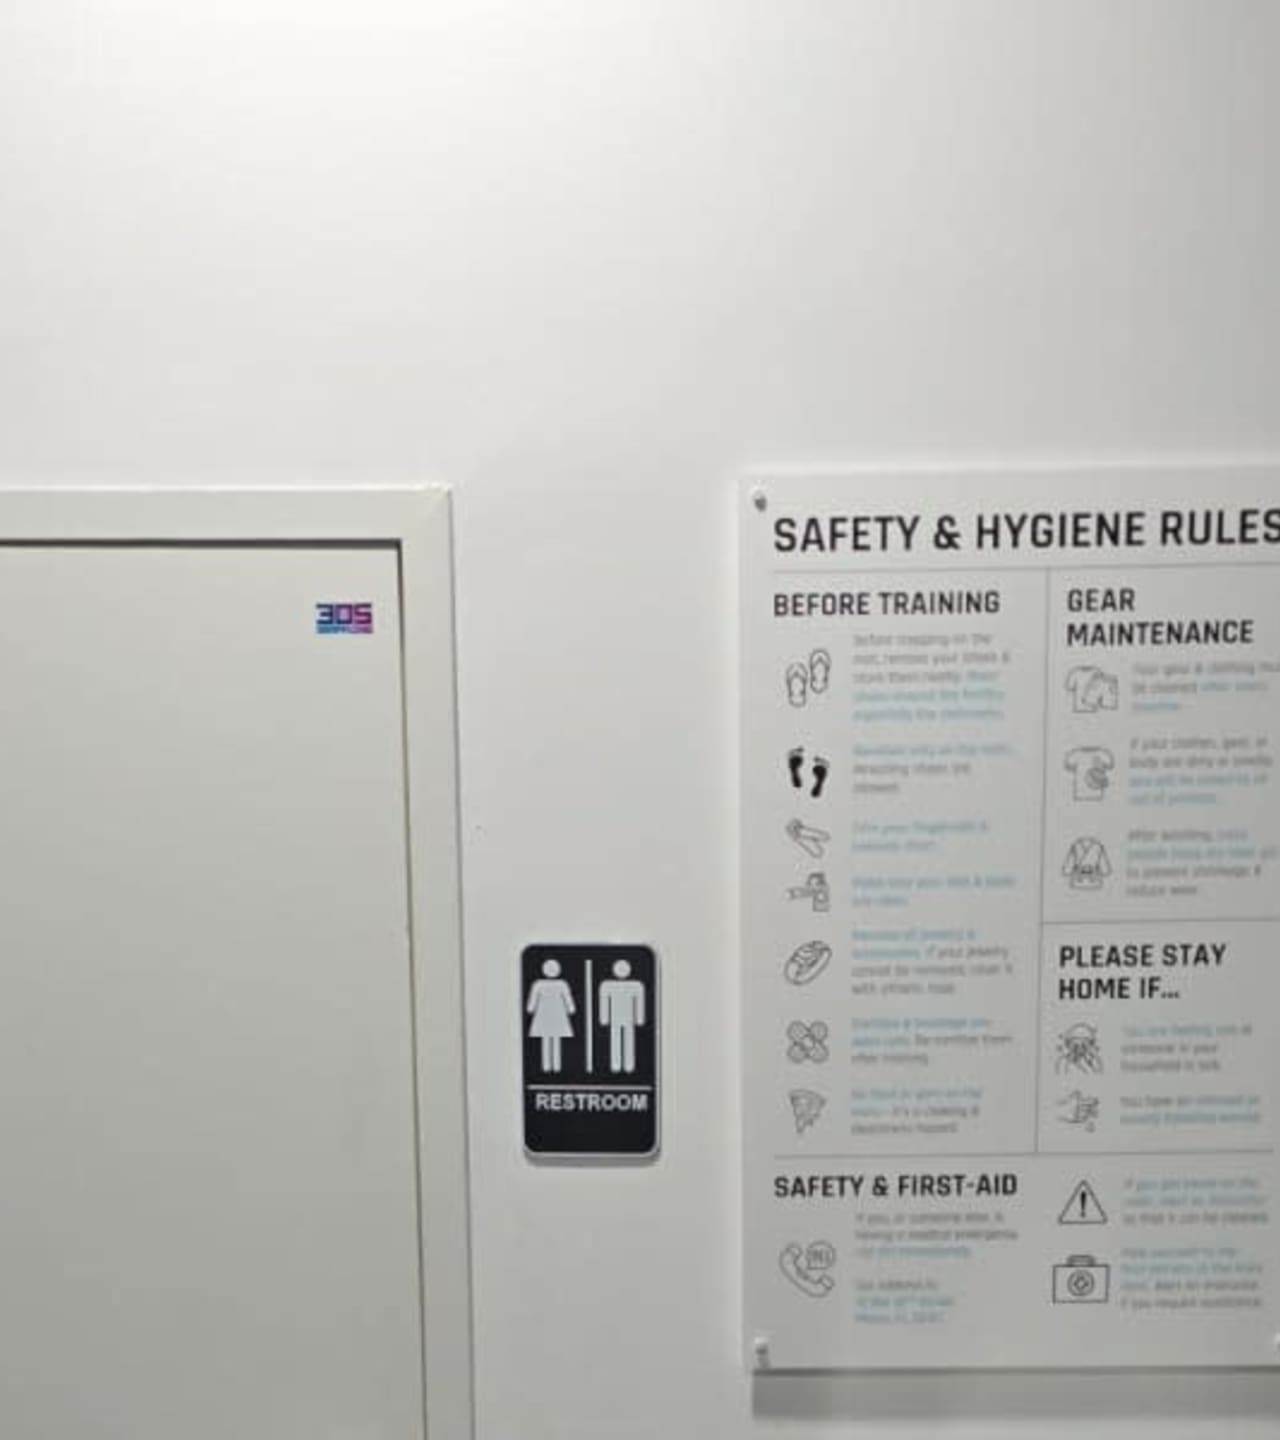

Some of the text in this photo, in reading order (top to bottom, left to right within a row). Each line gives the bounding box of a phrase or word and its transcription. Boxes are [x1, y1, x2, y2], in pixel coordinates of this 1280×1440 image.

[775, 516, 919, 552] SAFETY
[934, 515, 960, 549] &
[977, 512, 1144, 548] HYGIENE
[774, 591, 999, 616] BEFORE TRAINING
[1068, 589, 1134, 611] GEAR
[1068, 620, 1252, 645] MAINTENANCE
[1060, 944, 1225, 967] PLEASE STAY
[1060, 977, 1178, 999] HOME IF...
[535, 1093, 648, 1111] RESTROOM
[775, 1174, 1017, 1197] SAFETY & FIRST-AID
